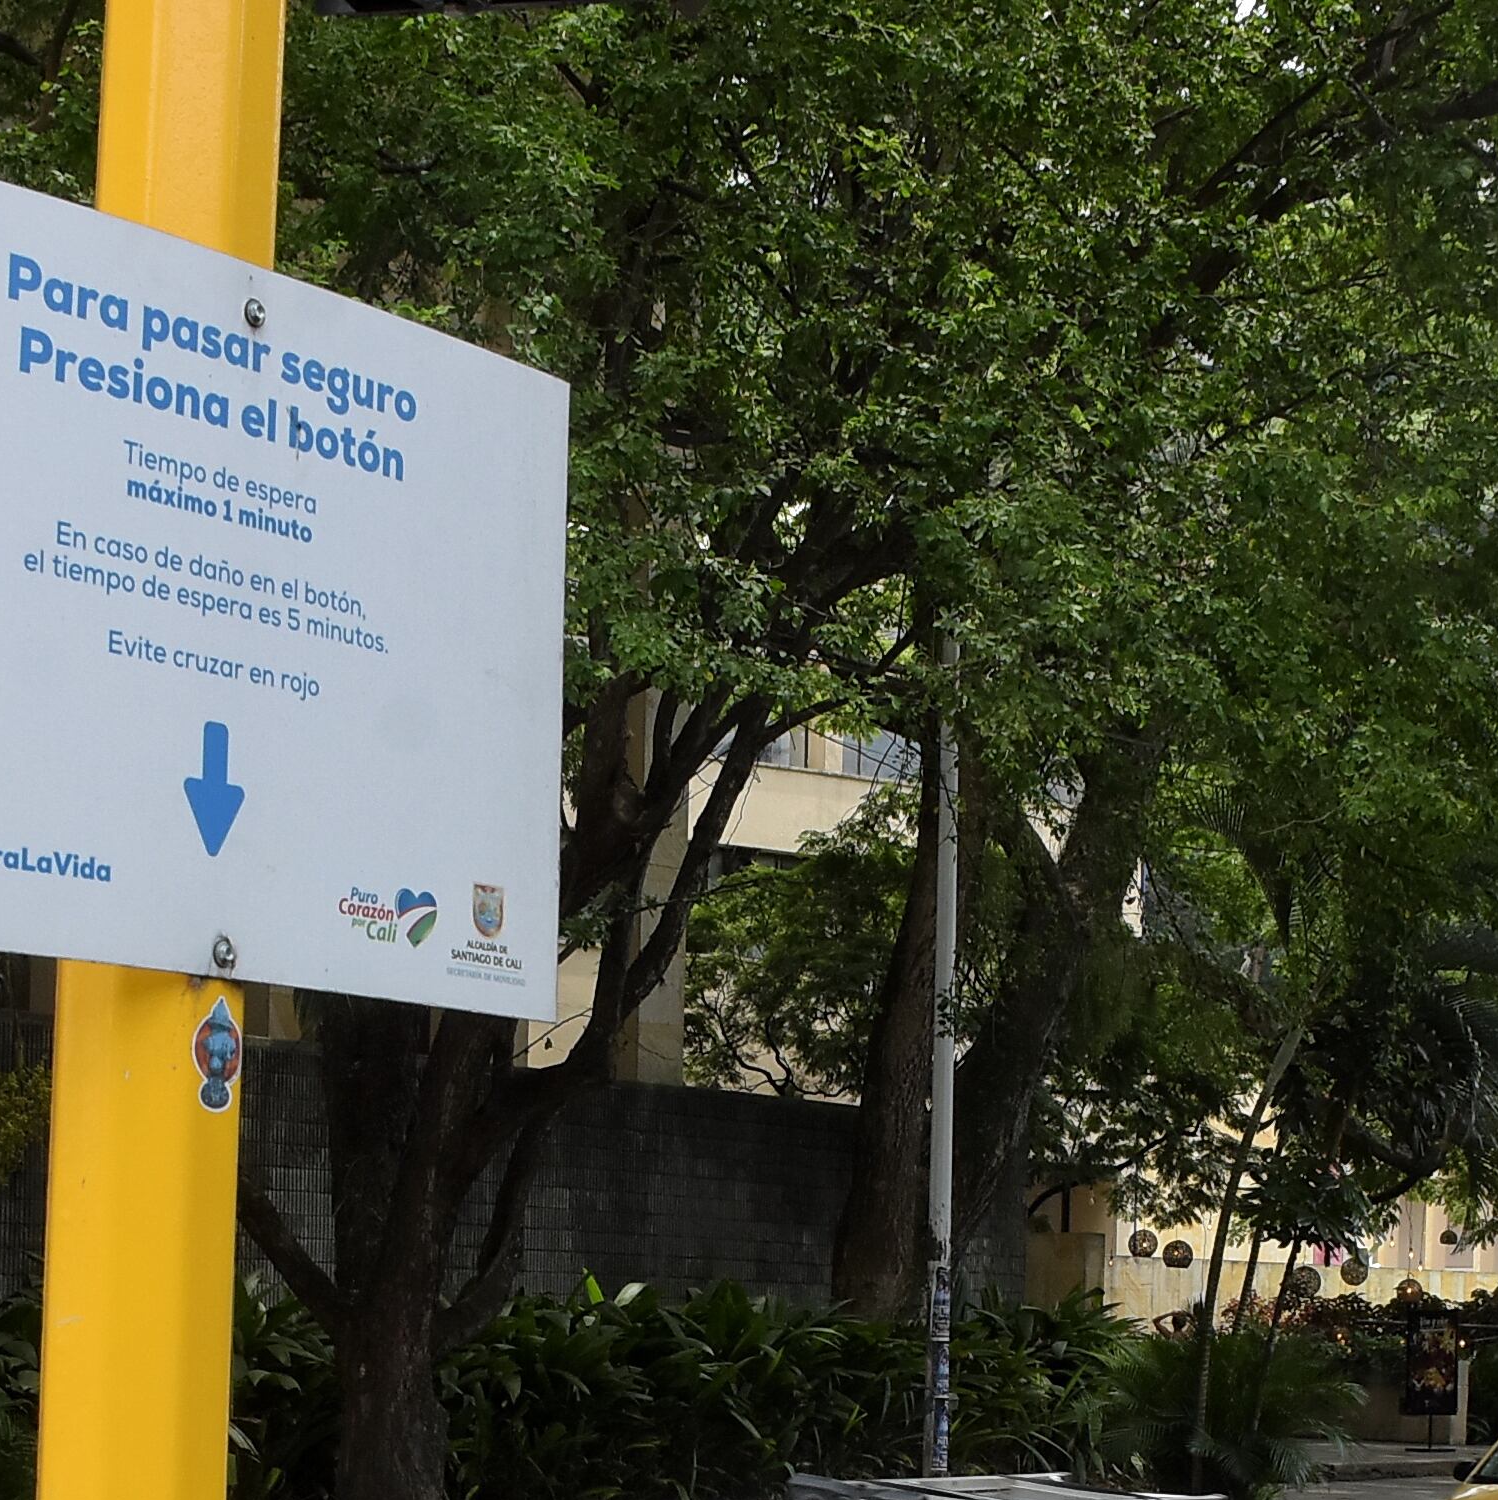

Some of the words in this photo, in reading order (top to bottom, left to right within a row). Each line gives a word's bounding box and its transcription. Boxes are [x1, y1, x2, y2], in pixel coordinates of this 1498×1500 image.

[7, 252, 130, 331] Para
[141, 305, 272, 373] pasar
[281, 351, 418, 423] seguro
[19, 325, 231, 429] Presiona
[239, 398, 279, 444] el
[286, 404, 406, 481] botón
[125, 438, 207, 486] Tiempo
[212, 468, 241, 492] de
[244, 479, 317, 515] espera
[126, 477, 219, 519] máximo
[222, 496, 234, 524] 1
[236, 505, 315, 544] minuto
[21, 551, 46, 571] el
[52, 555, 137, 593] tiempo
[141, 574, 171, 601] de
[175, 585, 255, 622] espera
[257, 605, 283, 626] es
[287, 606, 301, 632] 5
[307, 616, 390, 655] minutos.
[53, 519, 86, 548] En
[94, 533, 150, 565] caso
[155, 547, 182, 572] de
[189, 555, 246, 587] daño
[248, 571, 277, 592] en
[280, 580, 299, 599] el
[303, 582, 367, 621] botón,
[106, 627, 167, 664] Evite
[173, 647, 245, 679] cruzar
[248, 664, 277, 683] en
[278, 671, 320, 701] rojo
[338, 897, 395, 922] Corazón
[350, 886, 379, 905] Puro
[366, 920, 398, 943] Cali
[450, 948, 492, 965] SANTIAGO
[493, 955, 504, 967] DE
[505, 958, 523, 970] CALI
[499, 944, 509, 955] DE
